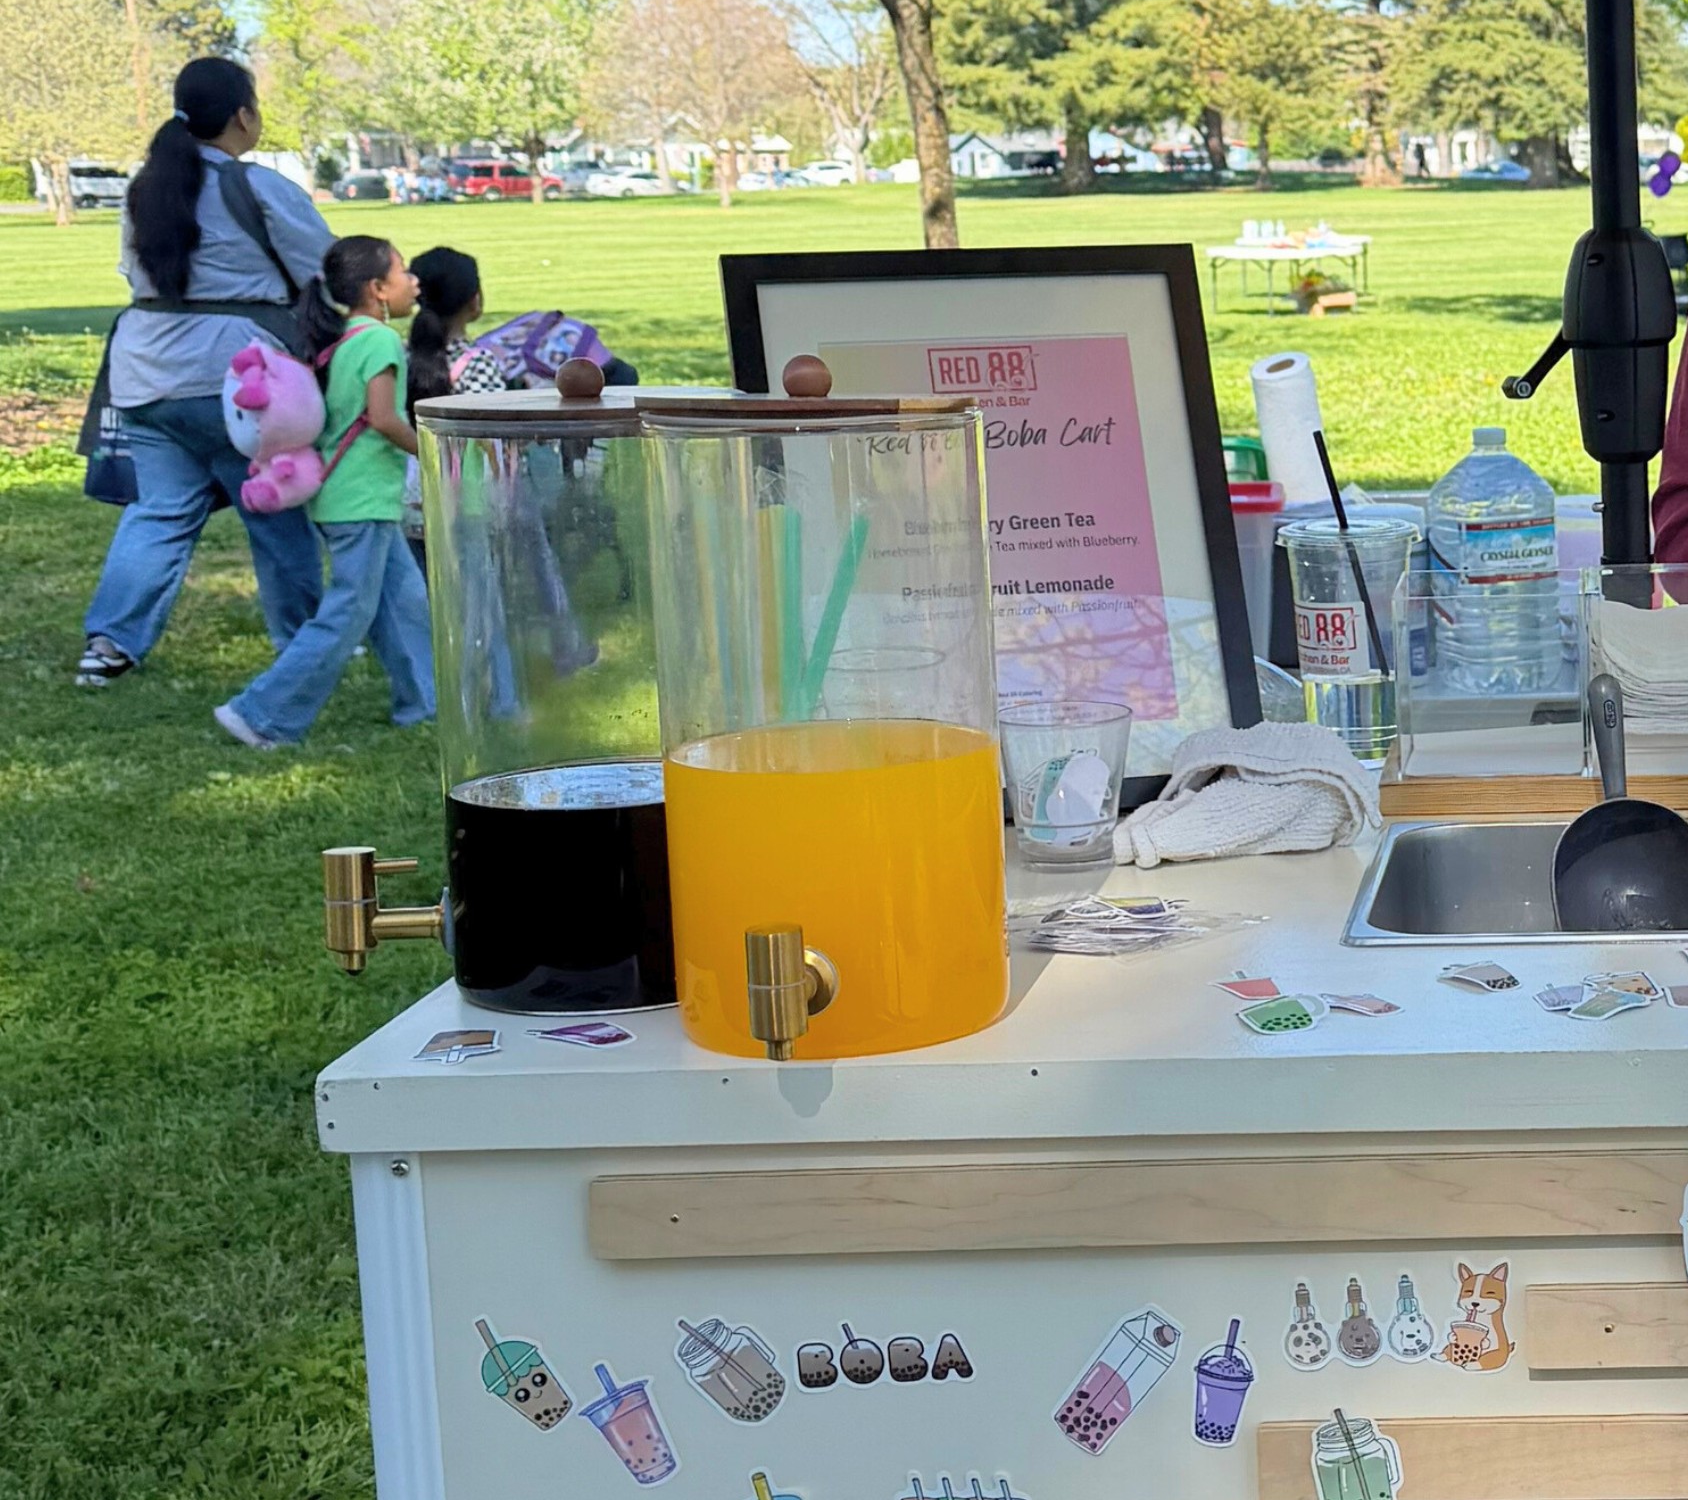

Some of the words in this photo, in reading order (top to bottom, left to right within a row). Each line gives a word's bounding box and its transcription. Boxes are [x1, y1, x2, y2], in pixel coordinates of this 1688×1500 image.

[938, 357, 981, 385] RED
[987, 351, 1027, 389] 88
[1009, 396, 1031, 407] Bar
[985, 420, 1047, 449] Boba
[1060, 417, 1116, 447] Cart
[1009, 514, 1060, 531] Green
[1065, 512, 1096, 528] Tea
[996, 540, 1016, 552] Tea
[1019, 538, 1053, 551] mixed
[1056, 536, 1080, 549] with
[1025, 574, 1115, 595] Lemonade
[1007, 603, 1041, 617] mixed
[1044, 602, 1068, 614] with
[1315, 613, 1346, 645] 88
[1331, 654, 1350, 665] Bar
[797, 1333, 974, 1388] BOBA
